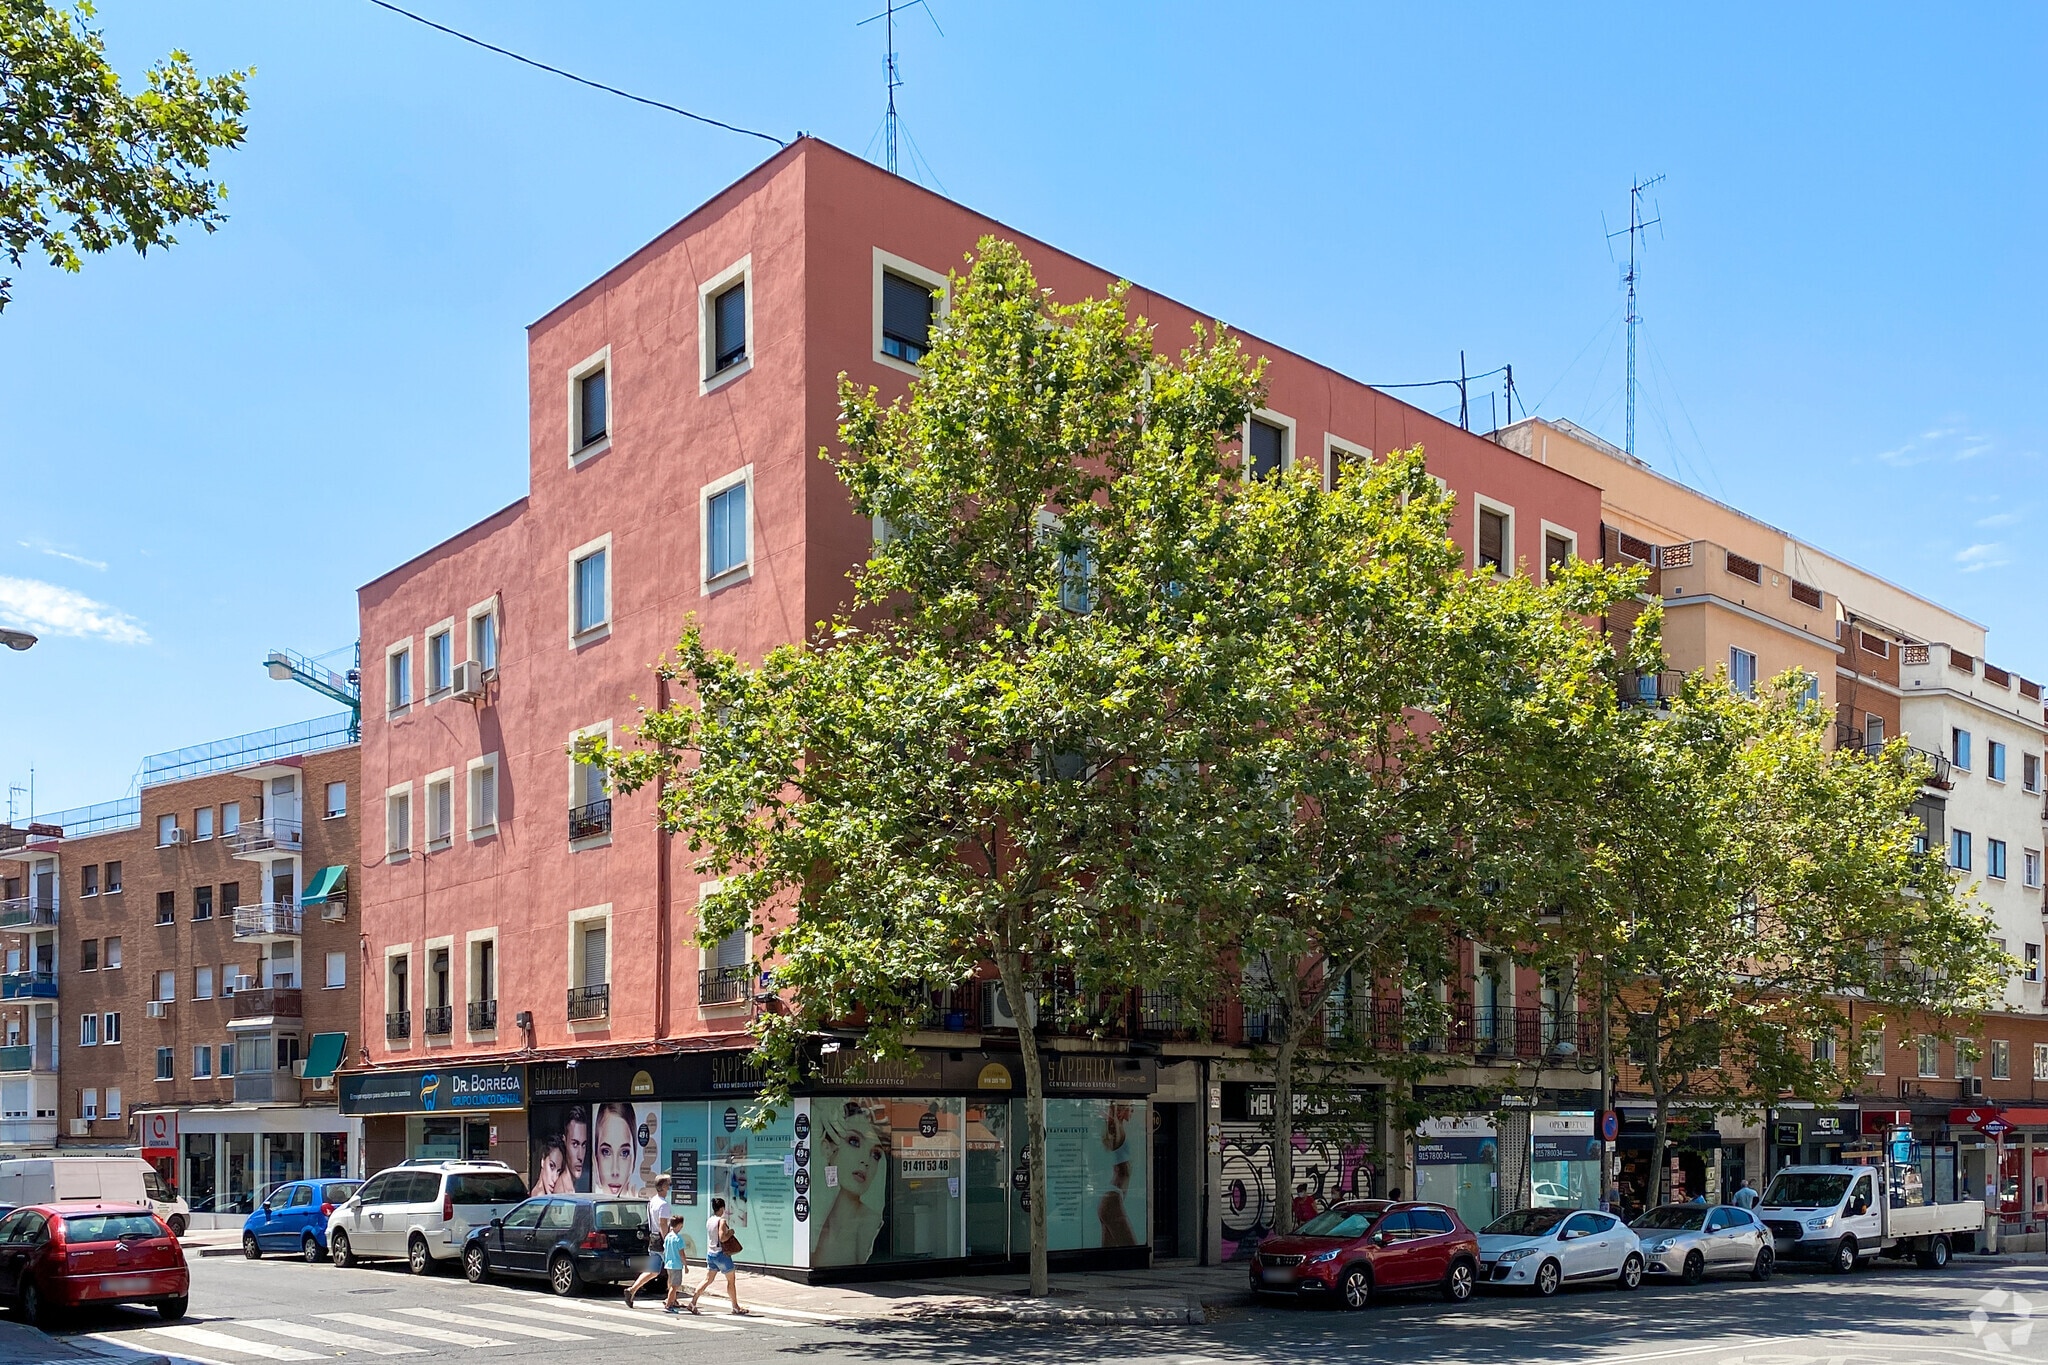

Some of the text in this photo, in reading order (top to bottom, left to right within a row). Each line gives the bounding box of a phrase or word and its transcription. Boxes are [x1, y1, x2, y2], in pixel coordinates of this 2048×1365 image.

[1048, 1057, 1115, 1081] SAPPHIRA
[471, 1074, 520, 1092] BORREGA
[1071, 1080, 1092, 1088] MÉDICO
[452, 1093, 520, 1106] GRUPO CLÍNICO DENTAL
[1819, 1117, 1840, 1128] RETA
[922, 1125, 932, 1133] 29
[796, 1149, 804, 1158] 49
[903, 1160, 948, 1171] 91 411 53 48
[796, 1175, 804, 1185] 49
[1015, 1174, 1023, 1182] 49
[796, 1203, 804, 1212] 49
